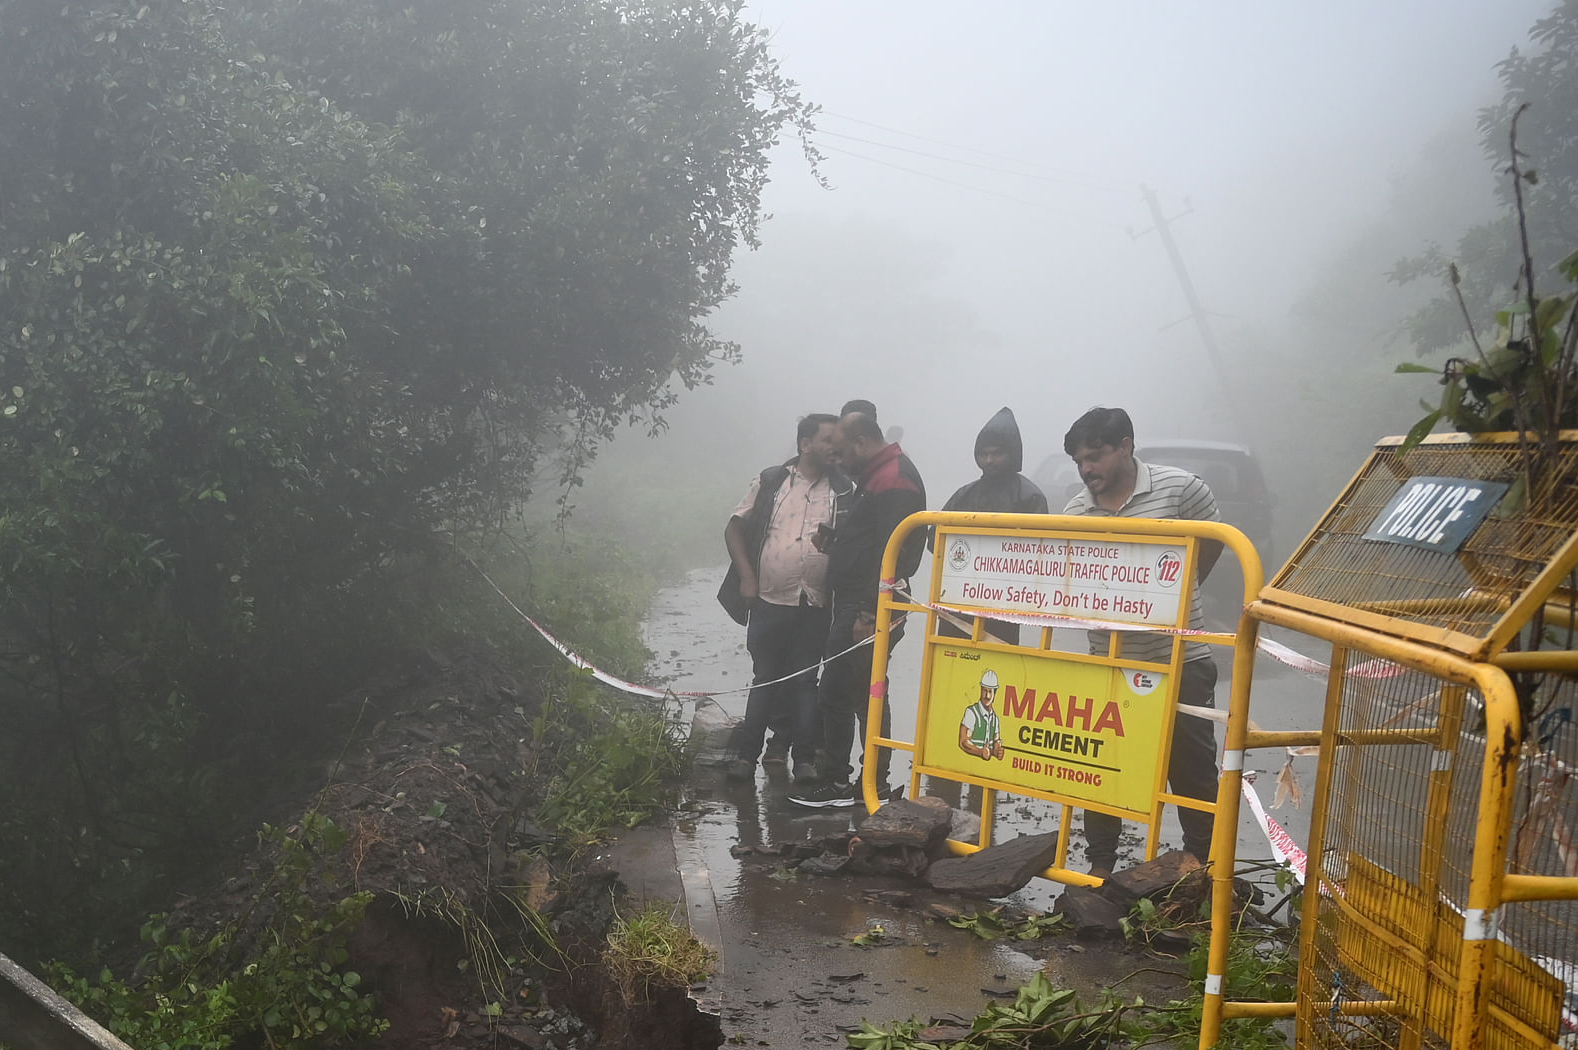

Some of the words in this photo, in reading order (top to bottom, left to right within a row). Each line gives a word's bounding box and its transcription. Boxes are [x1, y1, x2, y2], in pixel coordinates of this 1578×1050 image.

[1377, 483, 1482, 544] POLICE
[1001, 542, 1055, 556] KARNATAKA
[1058, 545, 1085, 557] STATE
[1088, 547, 1119, 559] POLICE
[973, 556, 1067, 577] CHIKKAMAGALURU
[1070, 562, 1109, 581] TRAFFIC
[1111, 565, 1150, 584] POLICE
[1159, 560, 1181, 582] 112
[963, 583, 1003, 601] Follow
[1006, 586, 1049, 609] Safety,
[1053, 590, 1089, 609] Don’t
[1092, 593, 1109, 611] be
[1113, 595, 1153, 619] Hasty
[1003, 685, 1125, 737] MAHA
[1018, 725, 1104, 758] CEMENT
[1012, 757, 1042, 774] BUILD
[1044, 764, 1054, 777] IT
[1056, 766, 1102, 787] STRONG
